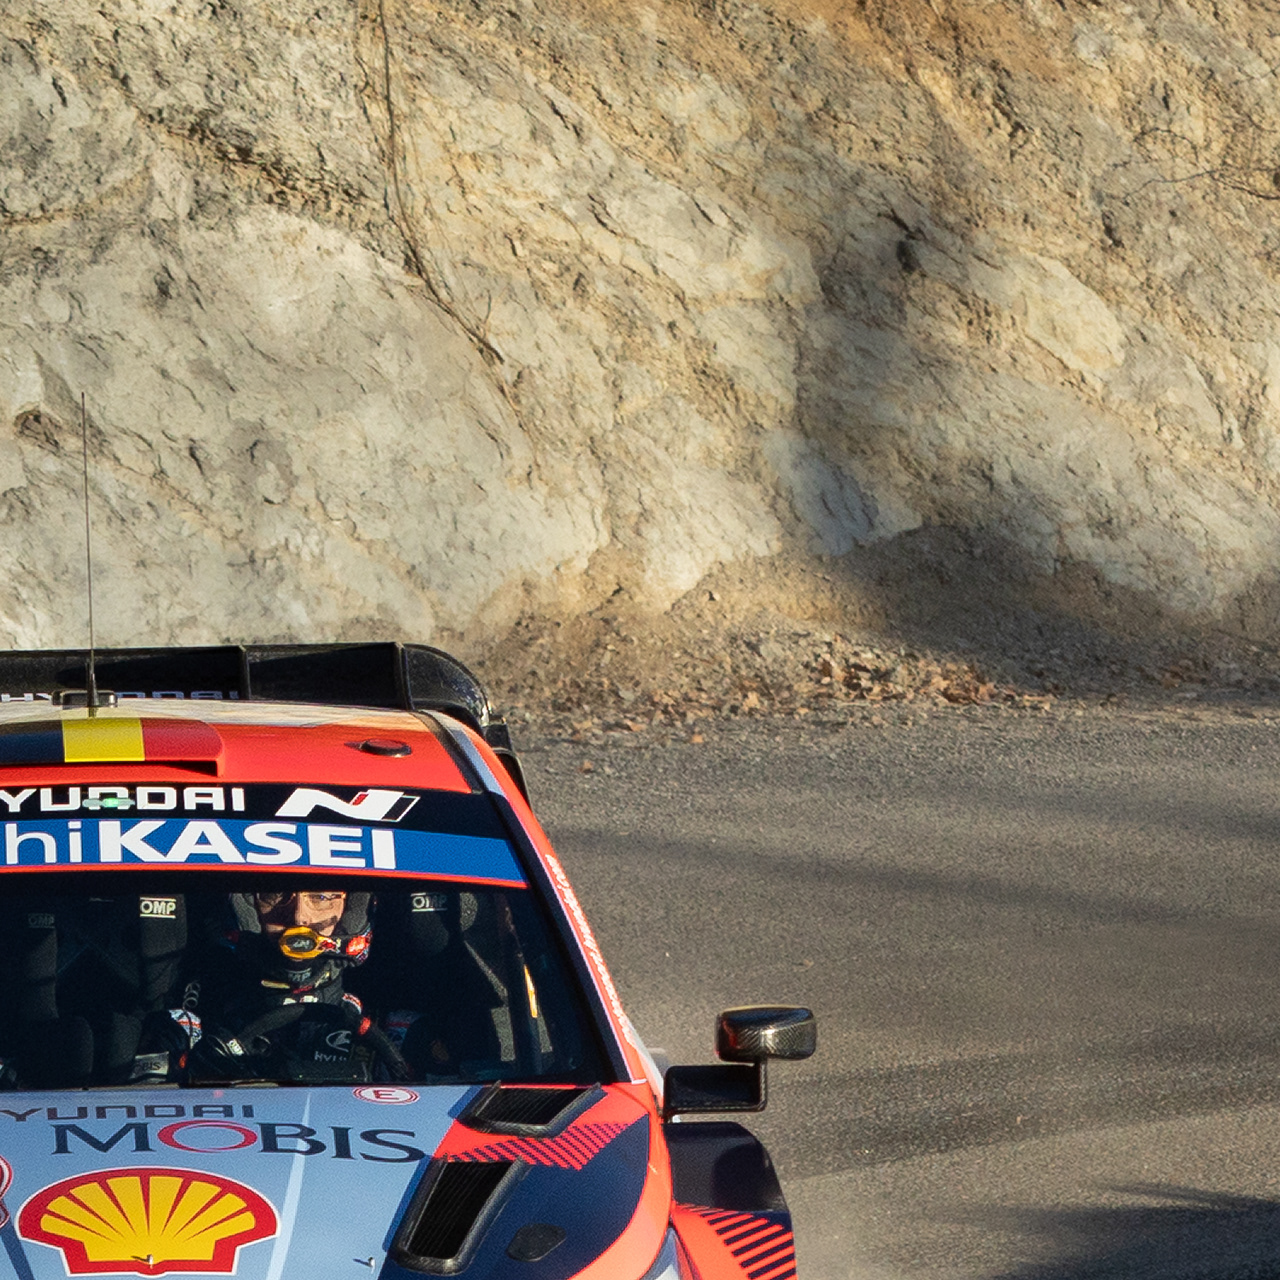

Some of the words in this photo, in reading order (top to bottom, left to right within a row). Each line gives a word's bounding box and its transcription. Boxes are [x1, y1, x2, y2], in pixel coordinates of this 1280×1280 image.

[1, 690, 239, 702] HNDAI
[140, 901, 176, 916] OMP
[51, 1119, 426, 1164] MOBIS
